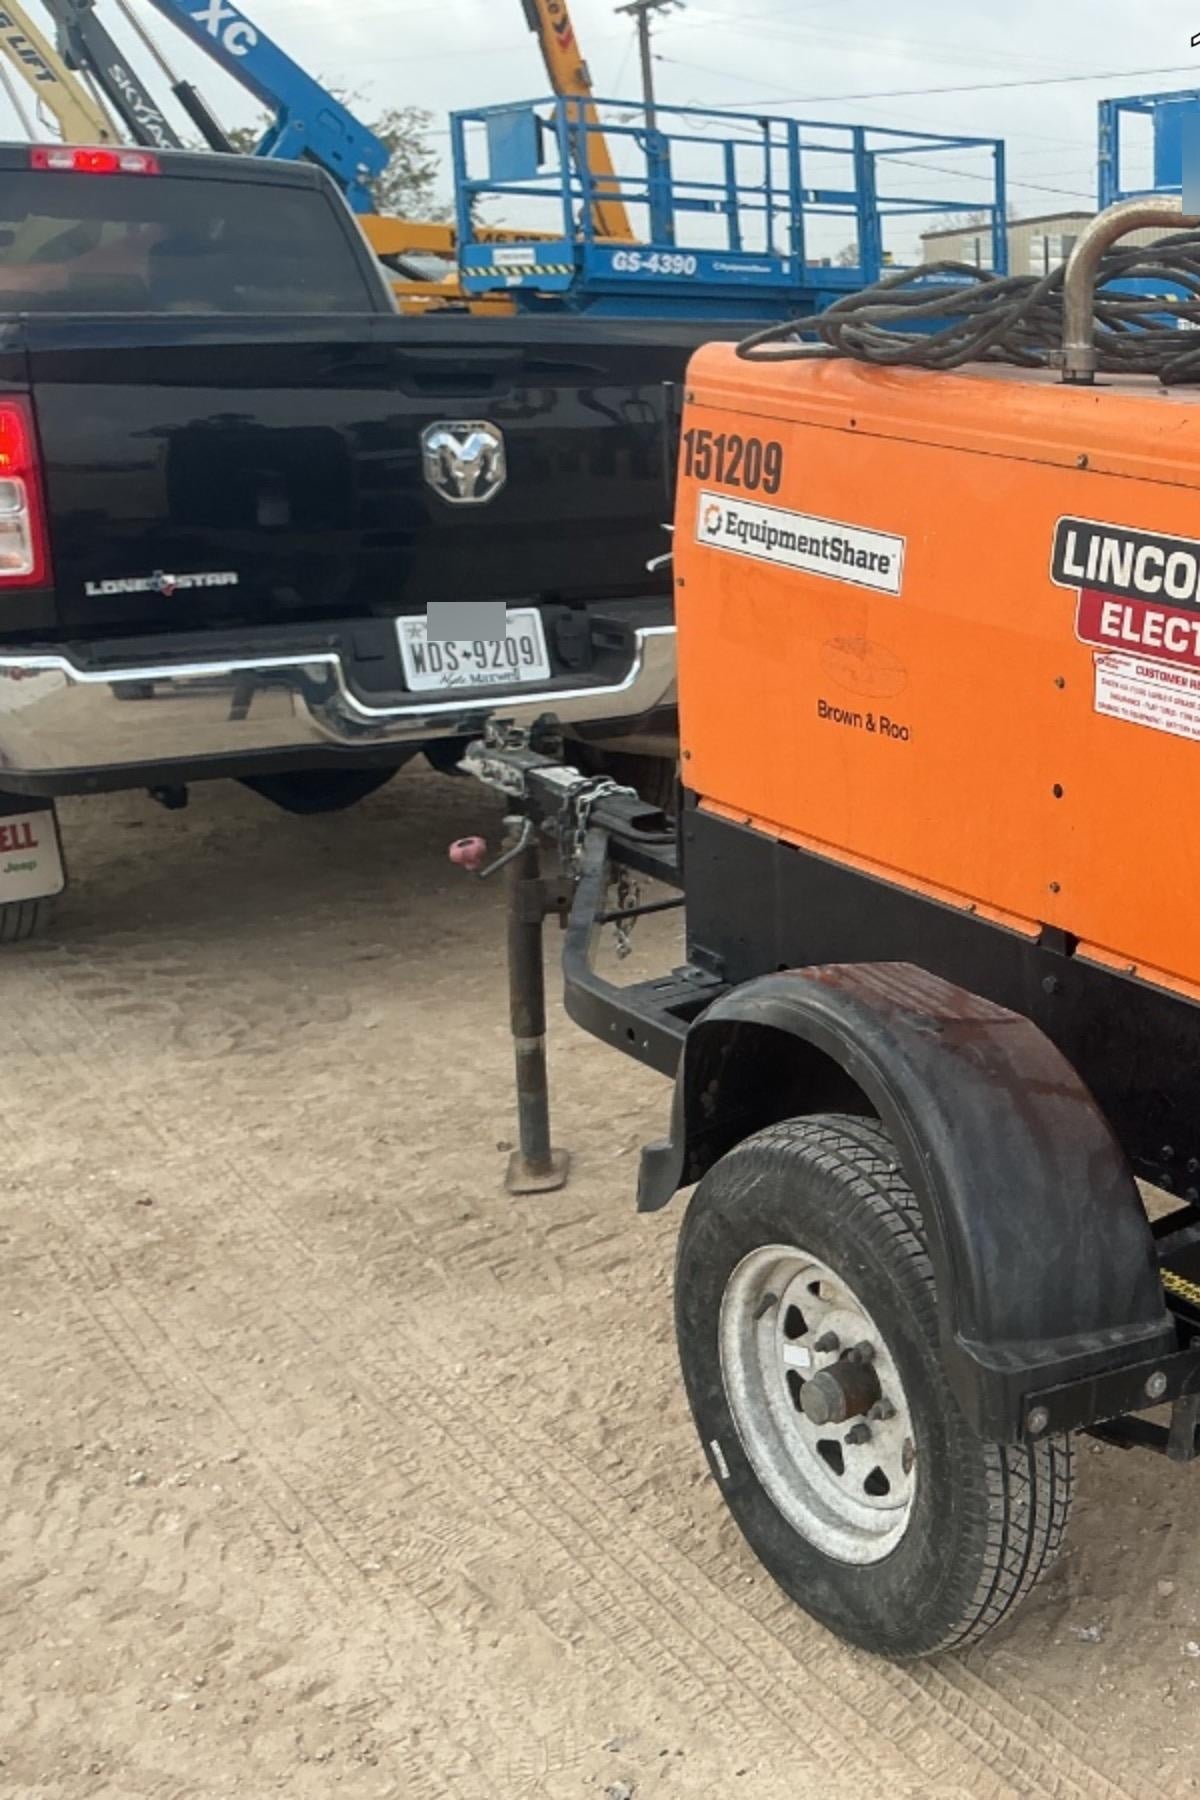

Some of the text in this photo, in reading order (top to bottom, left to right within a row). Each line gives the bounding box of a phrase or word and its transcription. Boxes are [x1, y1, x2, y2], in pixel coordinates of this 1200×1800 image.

[7, 36, 57, 82] LIFT
[612, 252, 697, 275] GS-4390
[684, 429, 783, 495] 151209
[726, 511, 890, 575] EquipmentShare
[85, 571, 239, 596] LONE STAR
[1135, 665, 1188, 687] CUSTOMER
[818, 699, 863, 728] Brown
[865, 713, 876, 732] &
